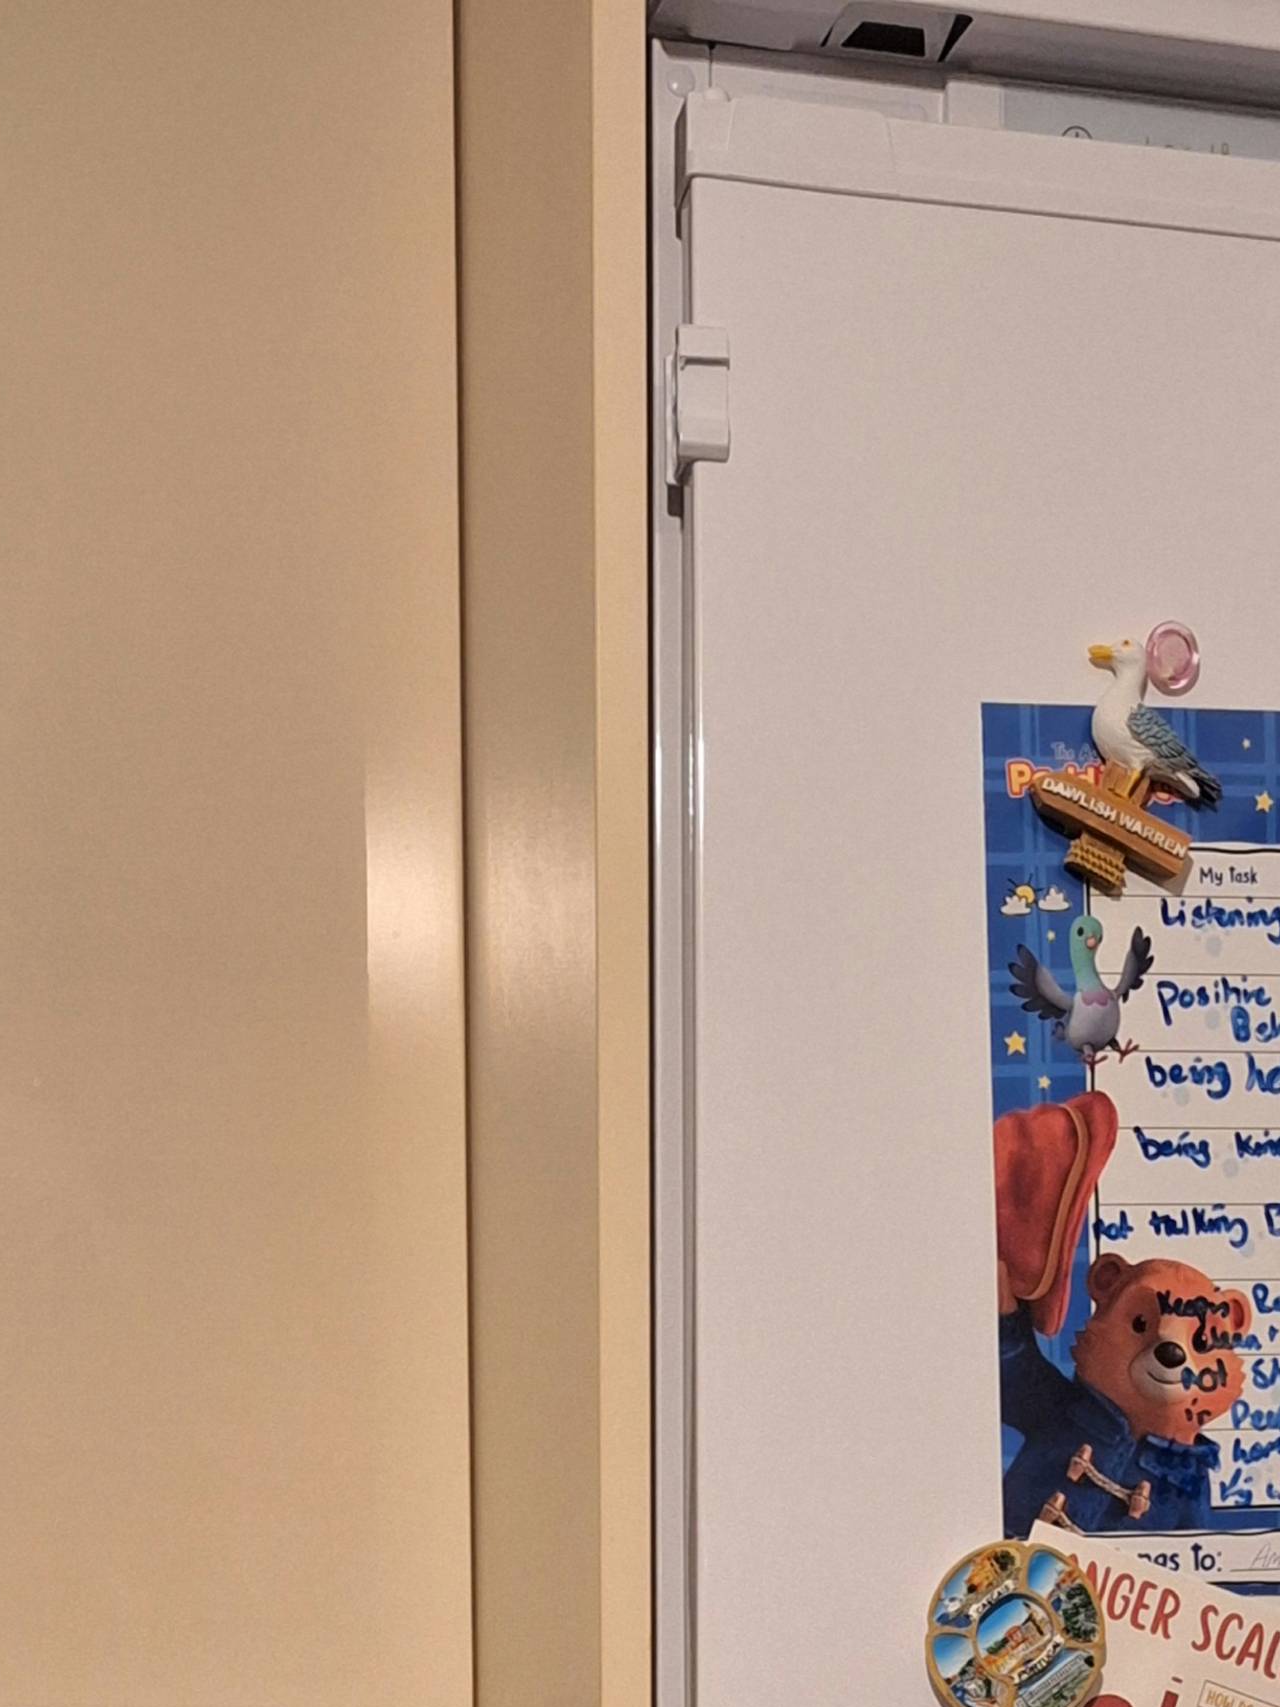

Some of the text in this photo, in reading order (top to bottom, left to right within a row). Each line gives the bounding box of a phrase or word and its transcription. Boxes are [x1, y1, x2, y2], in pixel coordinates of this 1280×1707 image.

[1040, 777, 1118, 822] DAWLISH
[1118, 808, 1188, 858] WARREN
[1200, 866, 1258, 887] My Task
[1145, 1056, 1232, 1099] being
[1190, 1543, 1222, 1573] to:
